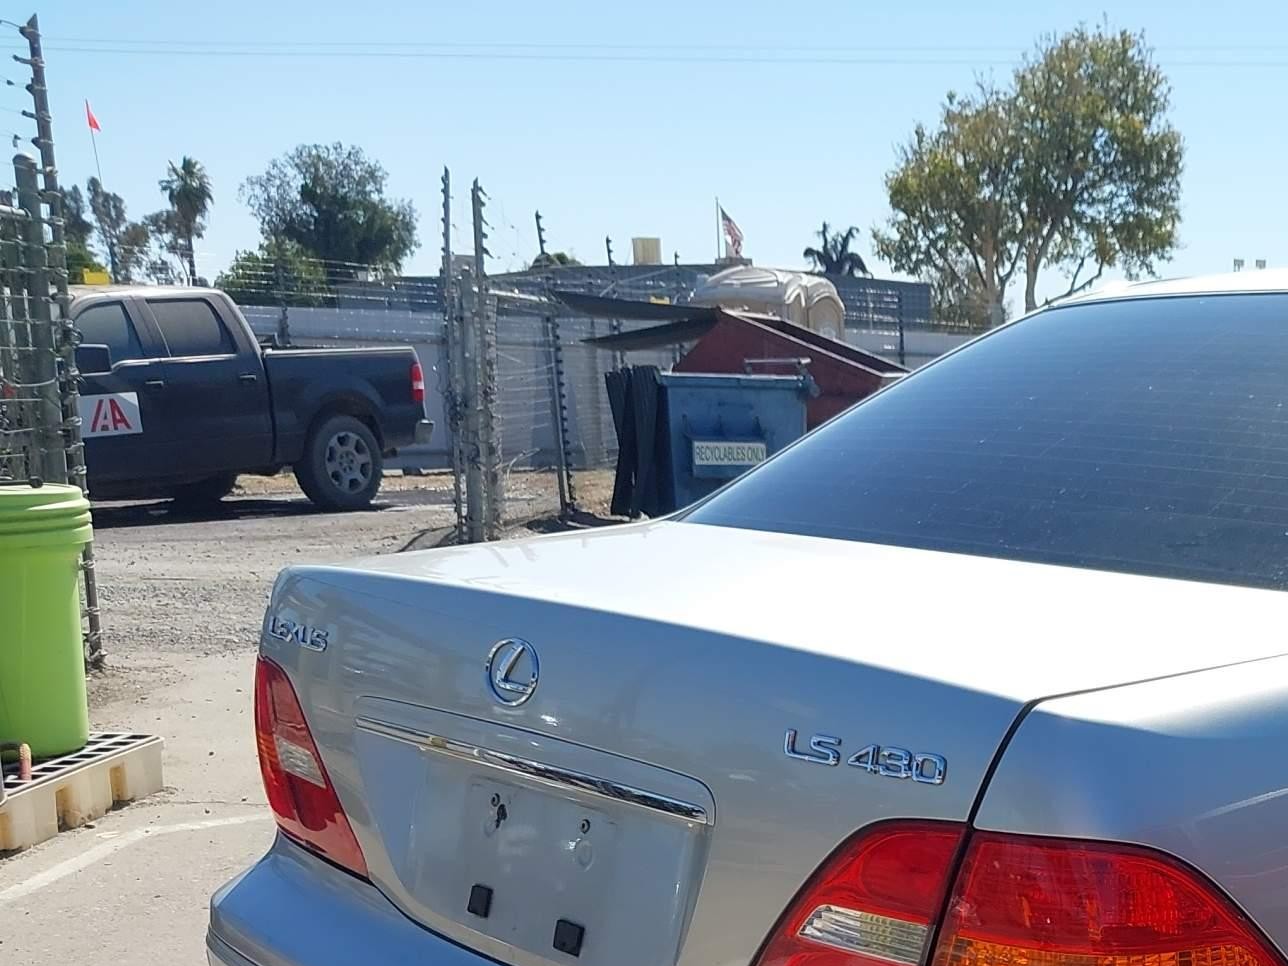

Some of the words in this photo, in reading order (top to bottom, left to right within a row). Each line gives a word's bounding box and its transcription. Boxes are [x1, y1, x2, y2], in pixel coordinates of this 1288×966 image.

[695, 445, 746, 462] RECYCLABLES
[746, 446, 766, 462] ONLY
[268, 615, 329, 653] LEXUS
[783, 728, 842, 766] LS
[847, 743, 948, 786] 430
